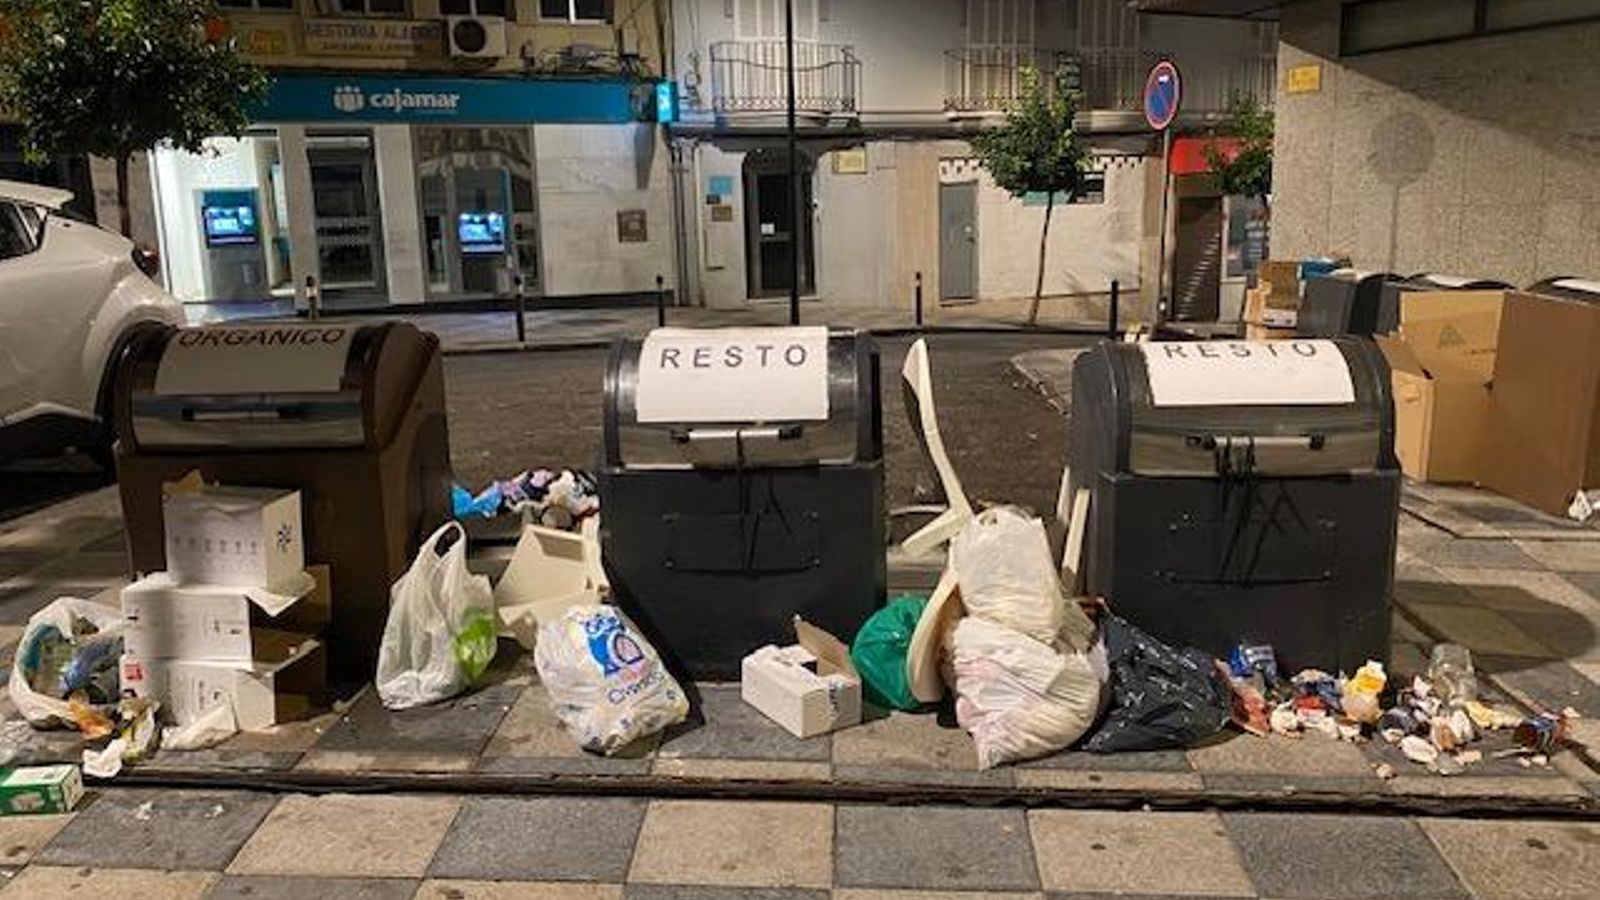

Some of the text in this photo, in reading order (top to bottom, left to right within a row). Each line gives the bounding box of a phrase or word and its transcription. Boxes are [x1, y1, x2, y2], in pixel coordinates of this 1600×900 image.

[370, 87, 460, 113] cajamar
[178, 327, 345, 346] ORGANICO
[660, 344, 808, 369] RESTO
[1162, 342, 1317, 358] RESTO
